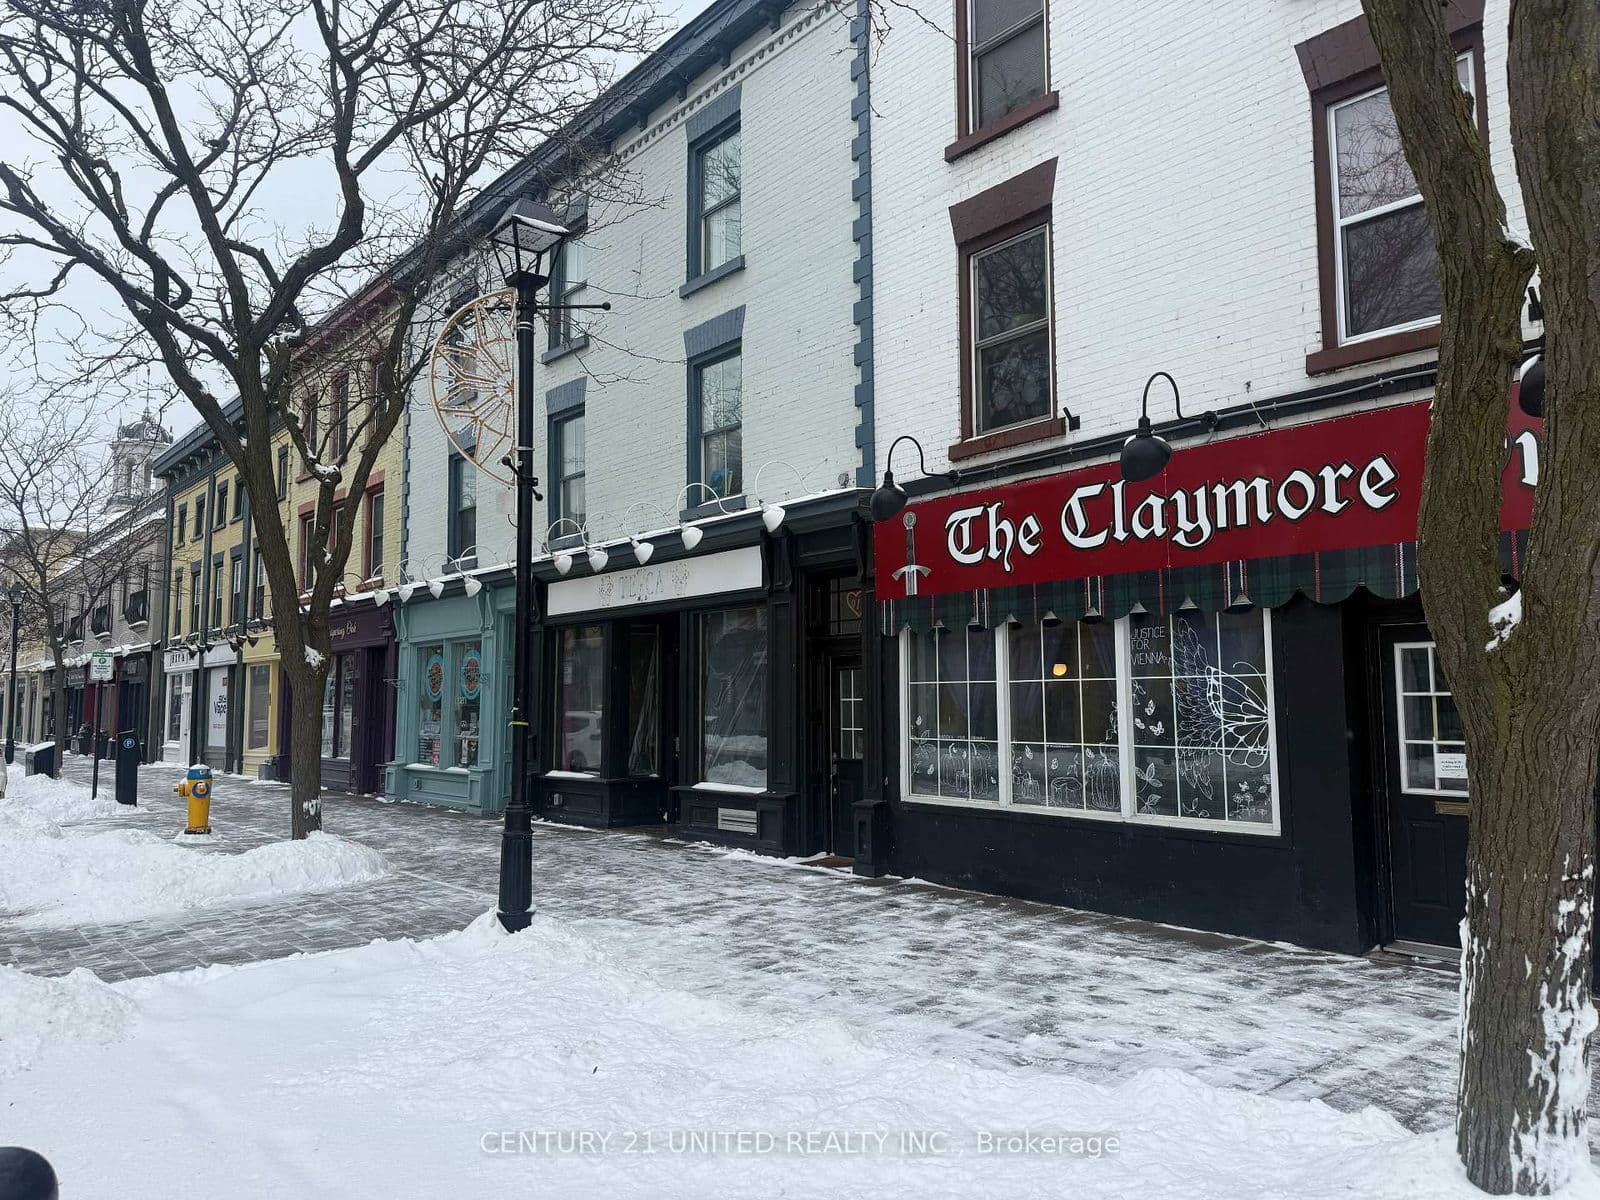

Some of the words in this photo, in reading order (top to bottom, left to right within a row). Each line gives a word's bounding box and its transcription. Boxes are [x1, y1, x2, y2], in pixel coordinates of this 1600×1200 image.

[945, 502, 1042, 573] The
[1060, 454, 1399, 548] Claymore
[1131, 626, 1166, 640] JUSTICE
[1131, 638, 1151, 651] FOR
[1131, 651, 1166, 666] VIENNA
